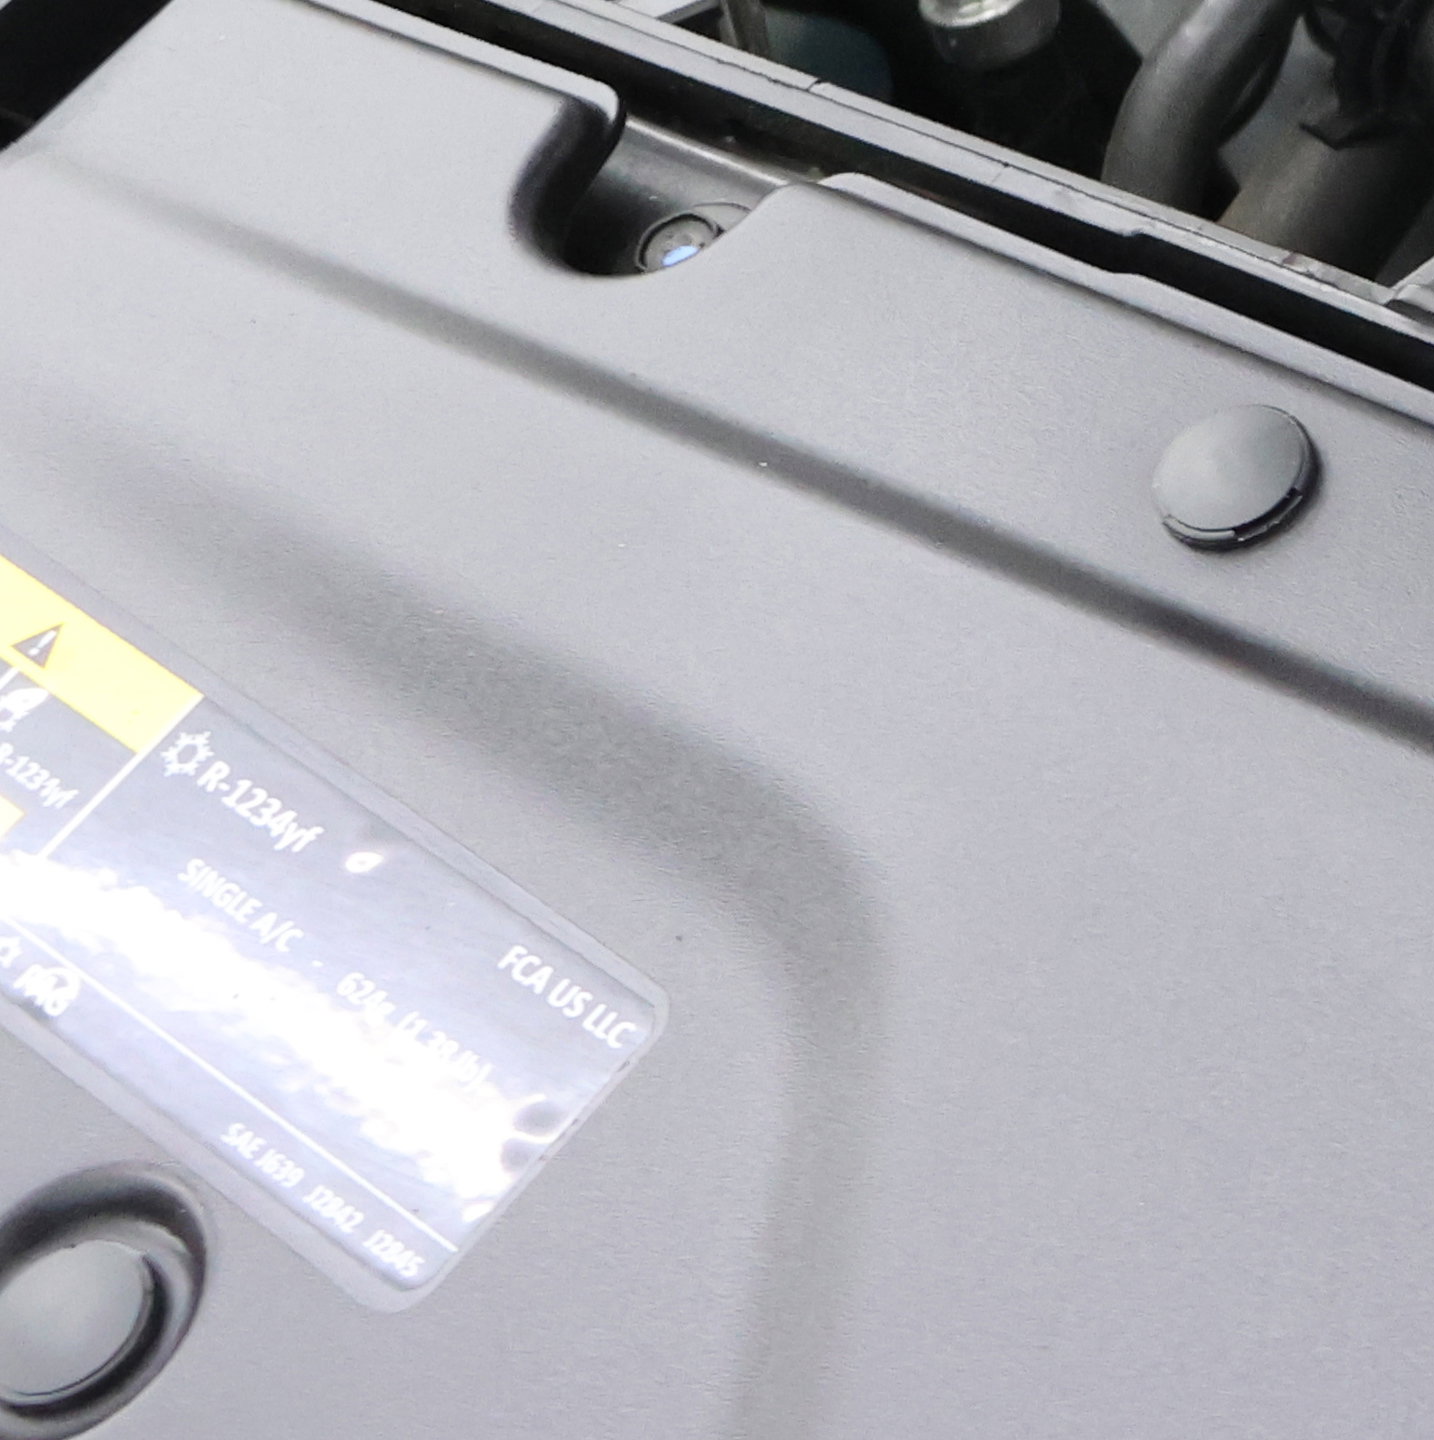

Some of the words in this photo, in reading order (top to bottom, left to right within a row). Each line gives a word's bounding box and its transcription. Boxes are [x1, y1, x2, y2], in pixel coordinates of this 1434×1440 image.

[197, 761, 325, 853] R-1234yf
[177, 858, 263, 923] SINGLE
[250, 912, 304, 952] A/C
[497, 945, 554, 994] FCA
[546, 979, 593, 1018] US
[581, 1004, 638, 1049] LLC
[220, 1122, 266, 1159] SAE
